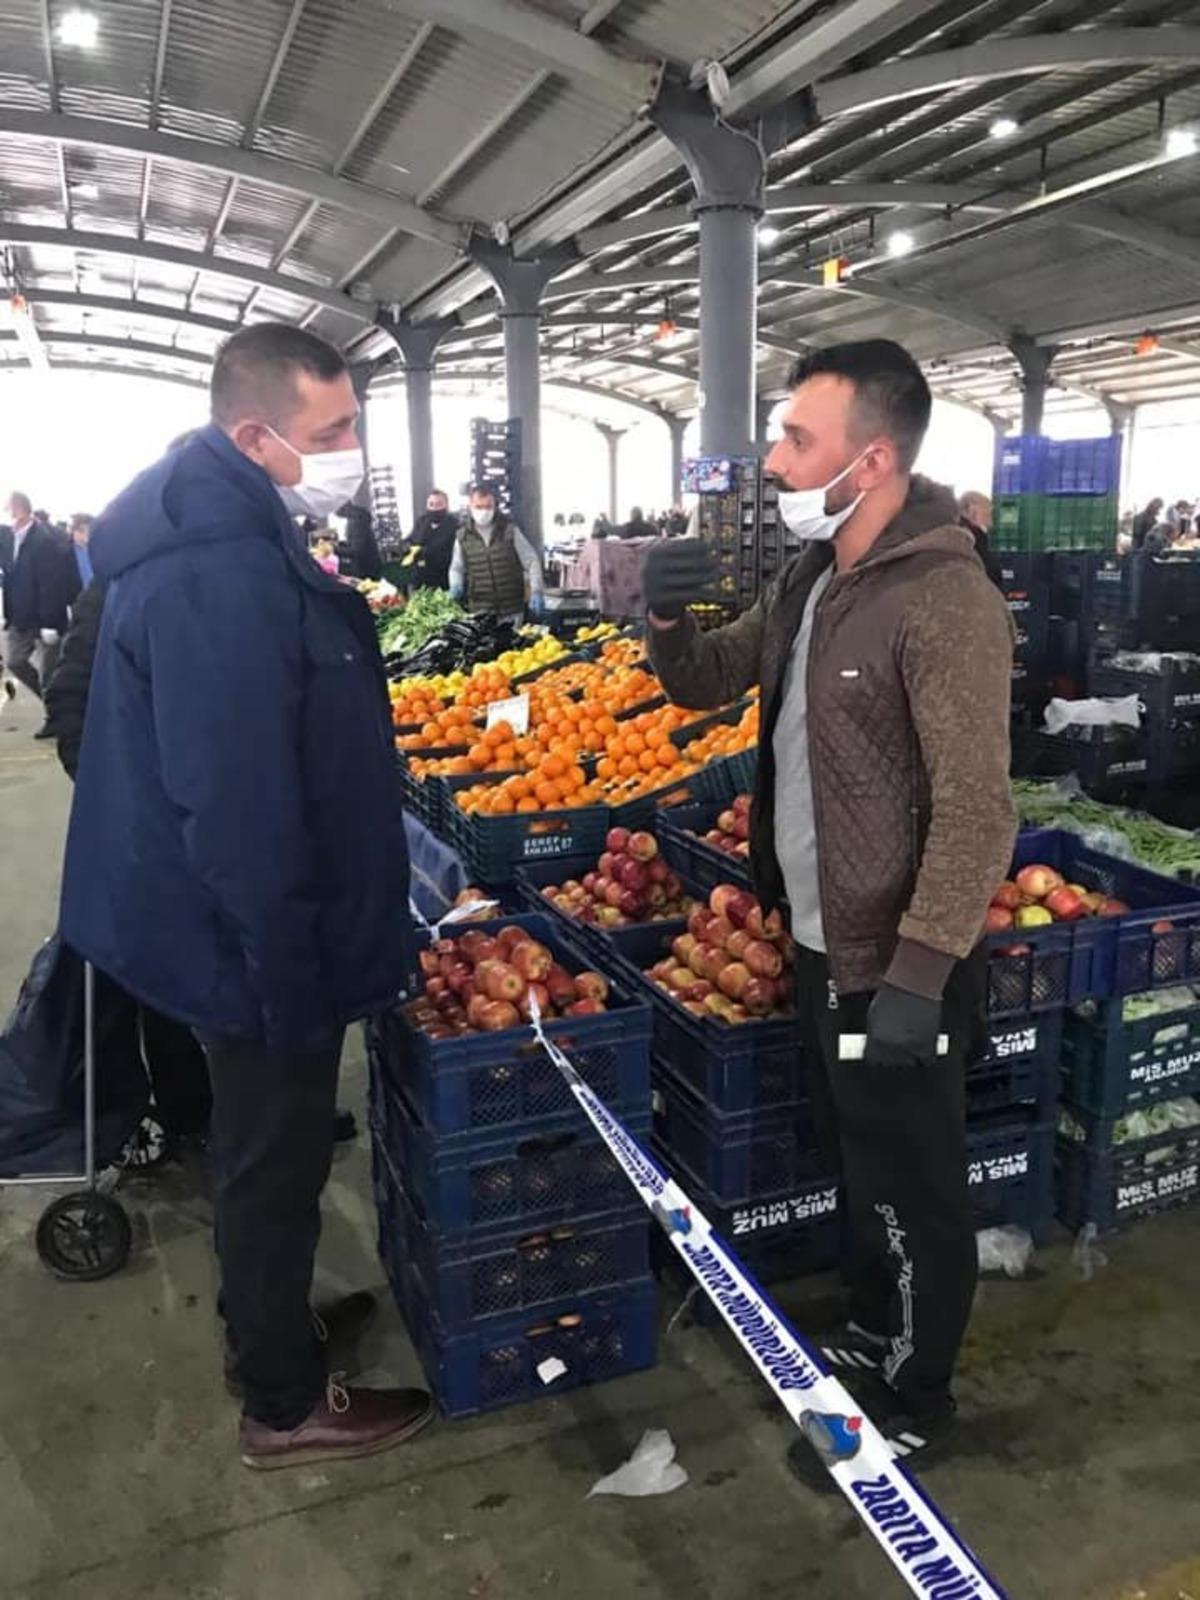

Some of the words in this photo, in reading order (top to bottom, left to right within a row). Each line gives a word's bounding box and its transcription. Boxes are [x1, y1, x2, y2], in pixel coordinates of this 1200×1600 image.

[733, 1209, 788, 1235] MUZ
[682, 1242, 738, 1292] ZABITA
[716, 1292, 819, 1390] MÜDÜRLÜĞÜ
[850, 1474, 939, 1563] ZABITA
